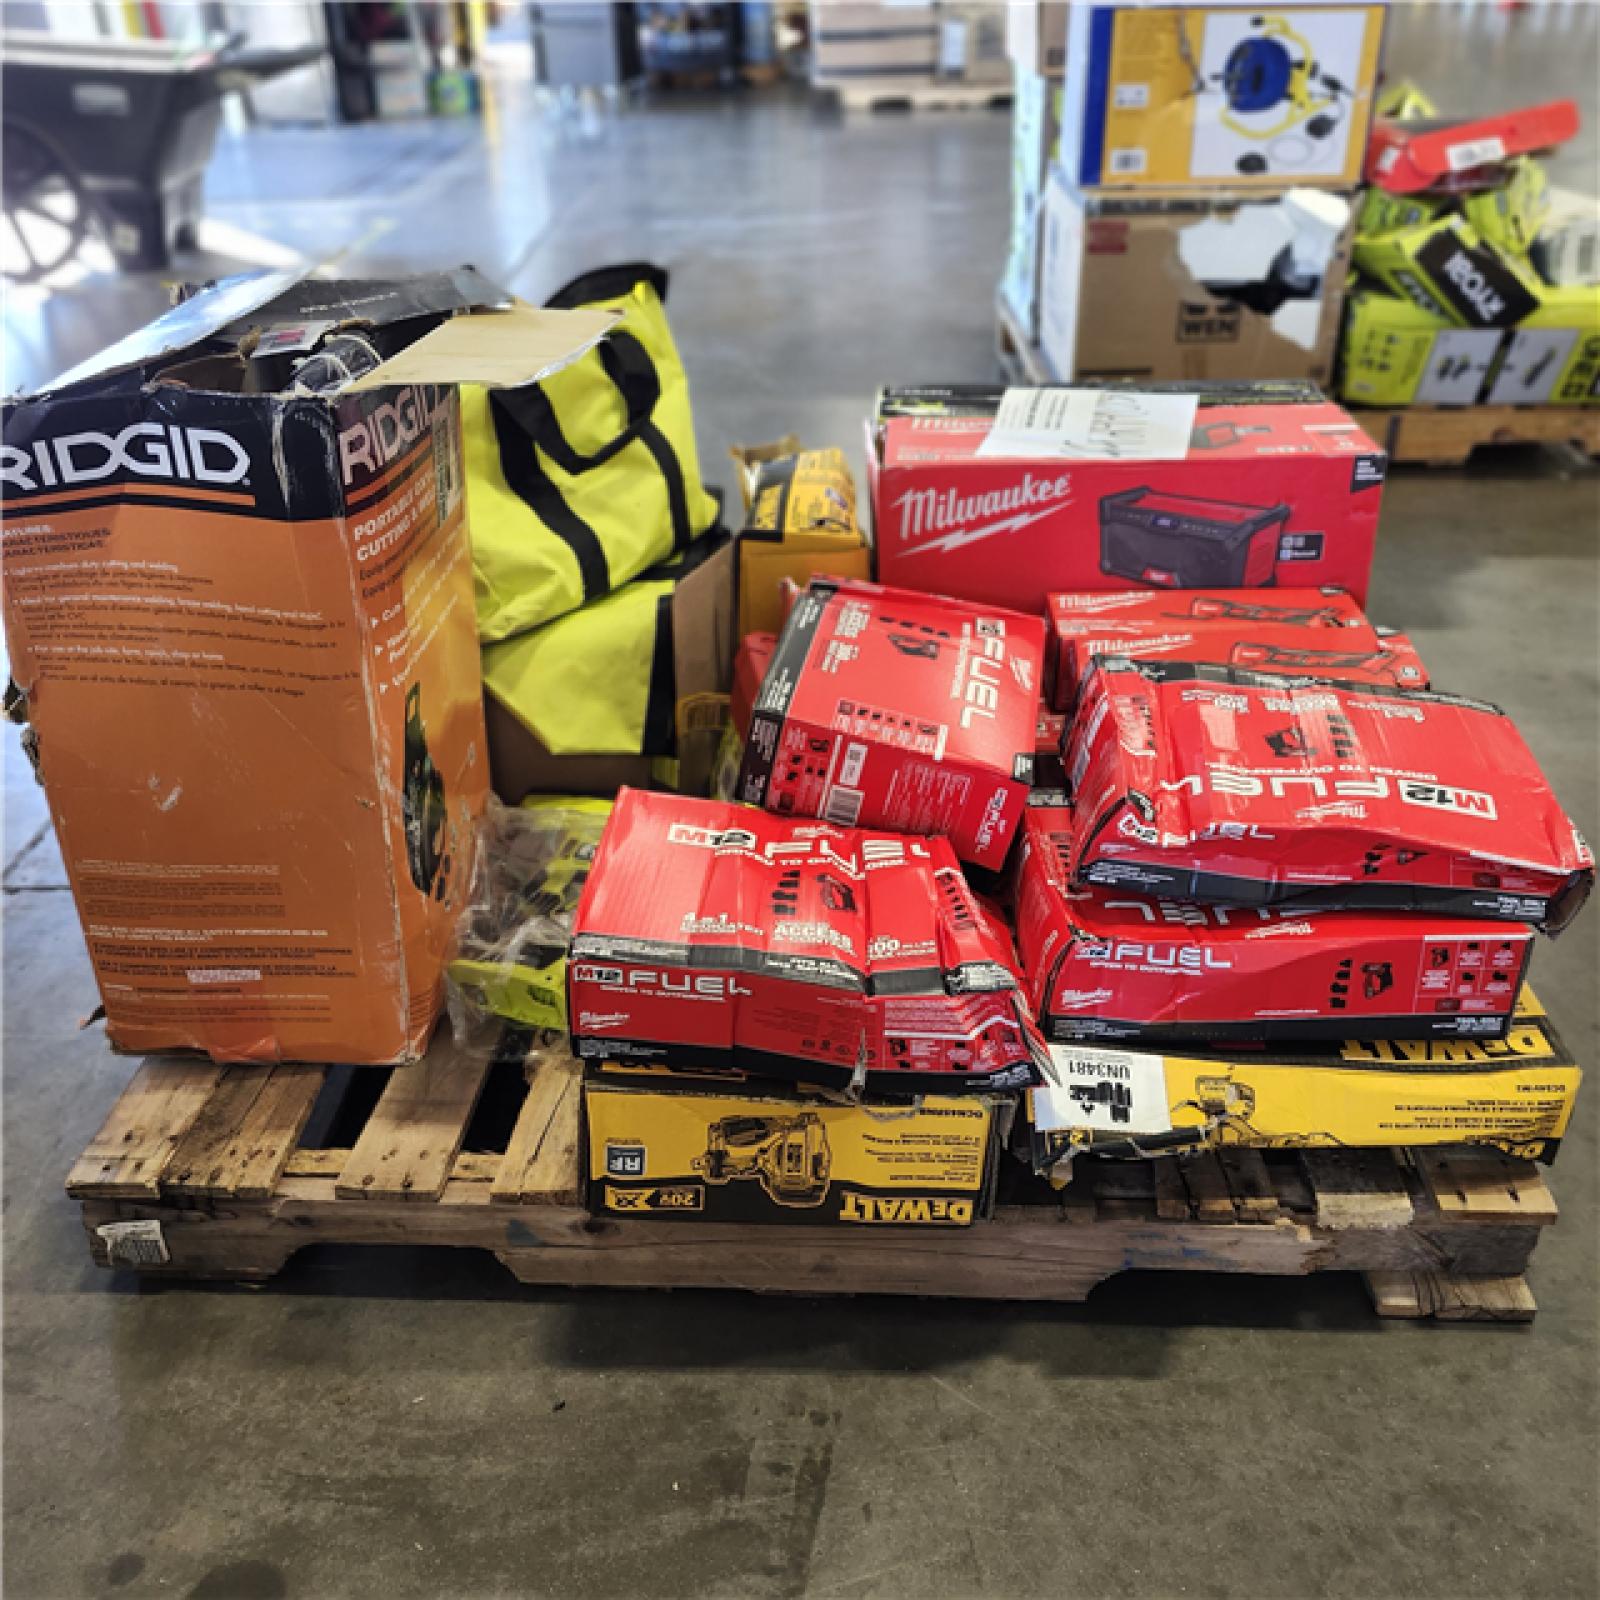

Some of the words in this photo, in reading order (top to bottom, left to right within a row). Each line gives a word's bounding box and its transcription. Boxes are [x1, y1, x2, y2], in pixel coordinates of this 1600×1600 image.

[2, 421, 251, 491] RIDGID
[890, 473, 1071, 541] Milwaukee
[1056, 588, 1155, 609] Milwaukee
[1084, 633, 1193, 656] Milwaukee
[958, 637, 1006, 729] FUEL
[1160, 771, 1389, 797] FUEL
[1401, 780, 1495, 817] M12
[669, 823, 756, 850] M12
[1114, 943, 1233, 968] FUEL
[629, 970, 753, 996] FUEL
[1069, 1059, 1131, 1081] UN3481
[840, 1194, 974, 1223] DeWALT
